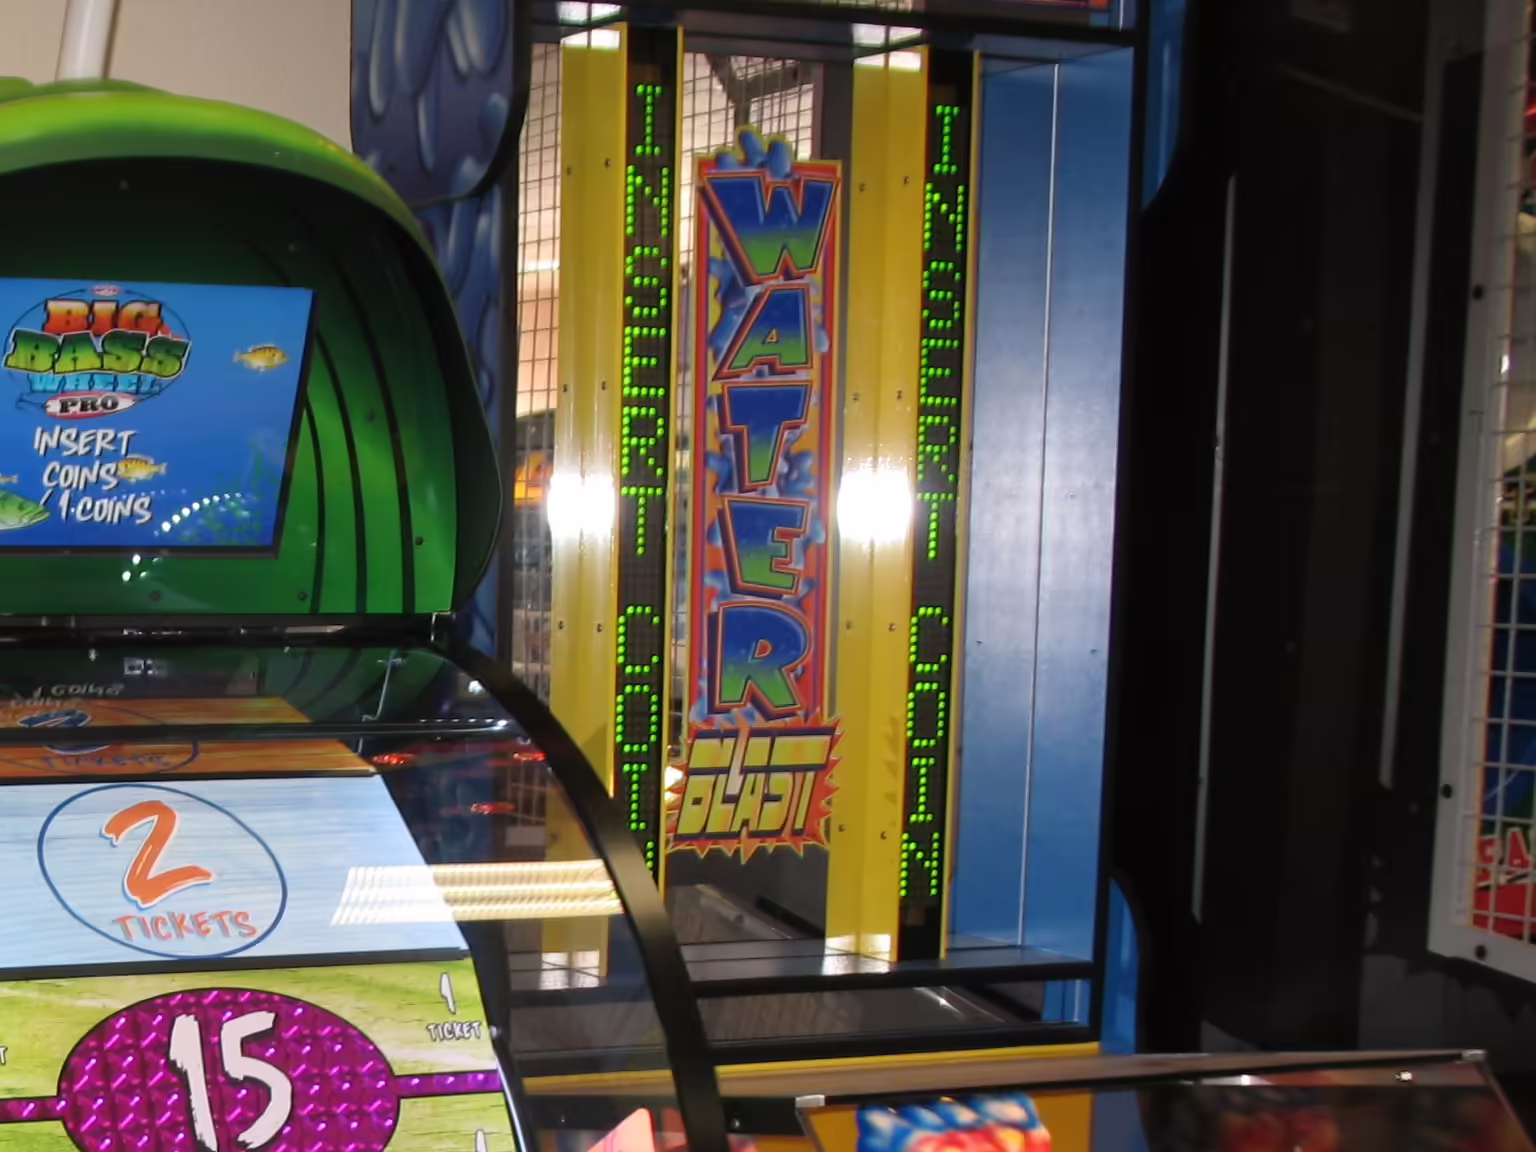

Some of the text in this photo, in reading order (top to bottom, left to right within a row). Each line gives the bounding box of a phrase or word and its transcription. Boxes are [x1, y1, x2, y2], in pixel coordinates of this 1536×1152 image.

[42, 298, 163, 337] BIG
[621, 84, 670, 555] INSERT
[917, 105, 965, 559] INSERT
[1, 328, 192, 379] BASS
[26, 372, 166, 394] WHEEL
[57, 394, 120, 414] PRO
[33, 425, 137, 457] INSERT
[697, 173, 841, 722] WATER
[42, 459, 120, 491] COINS
[75, 494, 153, 526] COINS
[616, 606, 661, 876] COI
[899, 606, 949, 896] COIN
[100, 800, 214, 911] 2
[112, 910, 259, 942] TICKETS
[440, 971, 457, 1015] 1
[427, 1021, 482, 1042] TICKET
[168, 1010, 292, 1152] 15
